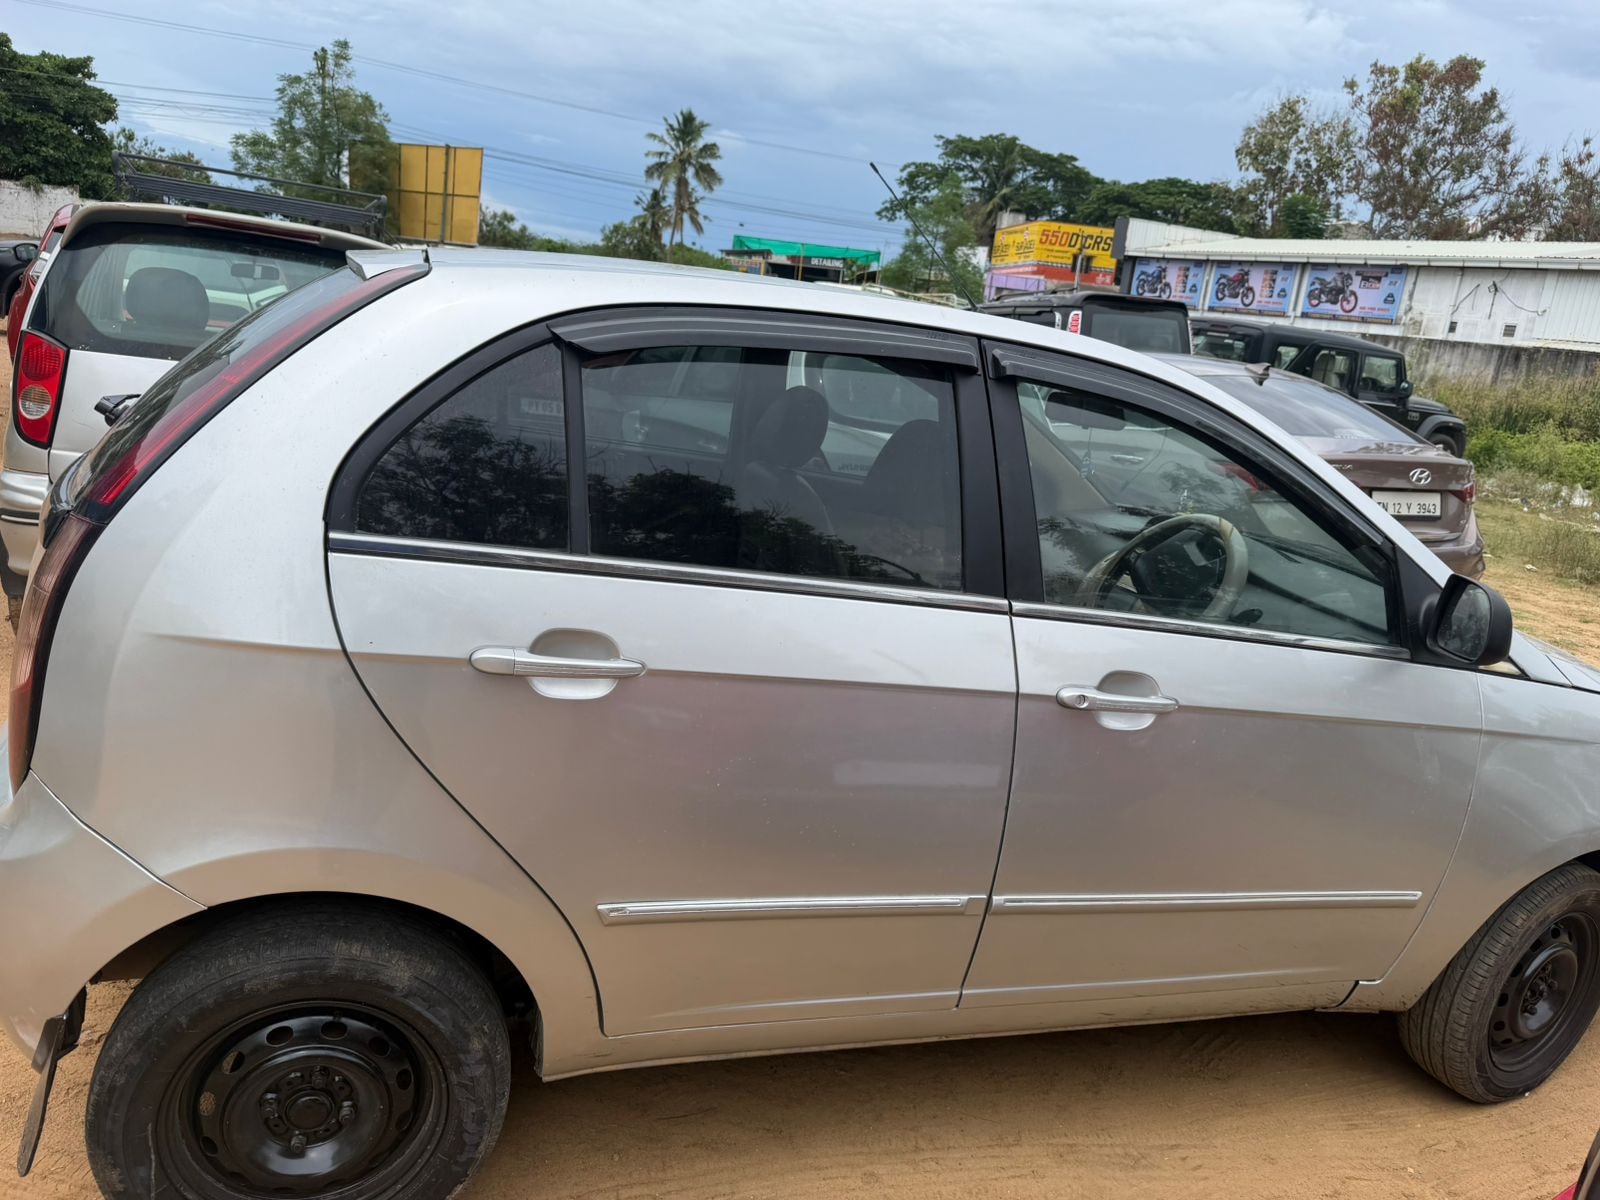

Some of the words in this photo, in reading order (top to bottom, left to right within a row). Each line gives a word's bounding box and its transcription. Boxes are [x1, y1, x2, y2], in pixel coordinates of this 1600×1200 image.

[810, 257, 844, 268] DETAILING
[1392, 502, 1402, 513] 12
[1406, 502, 1412, 513] Y
[1416, 503, 1437, 514] 3943
